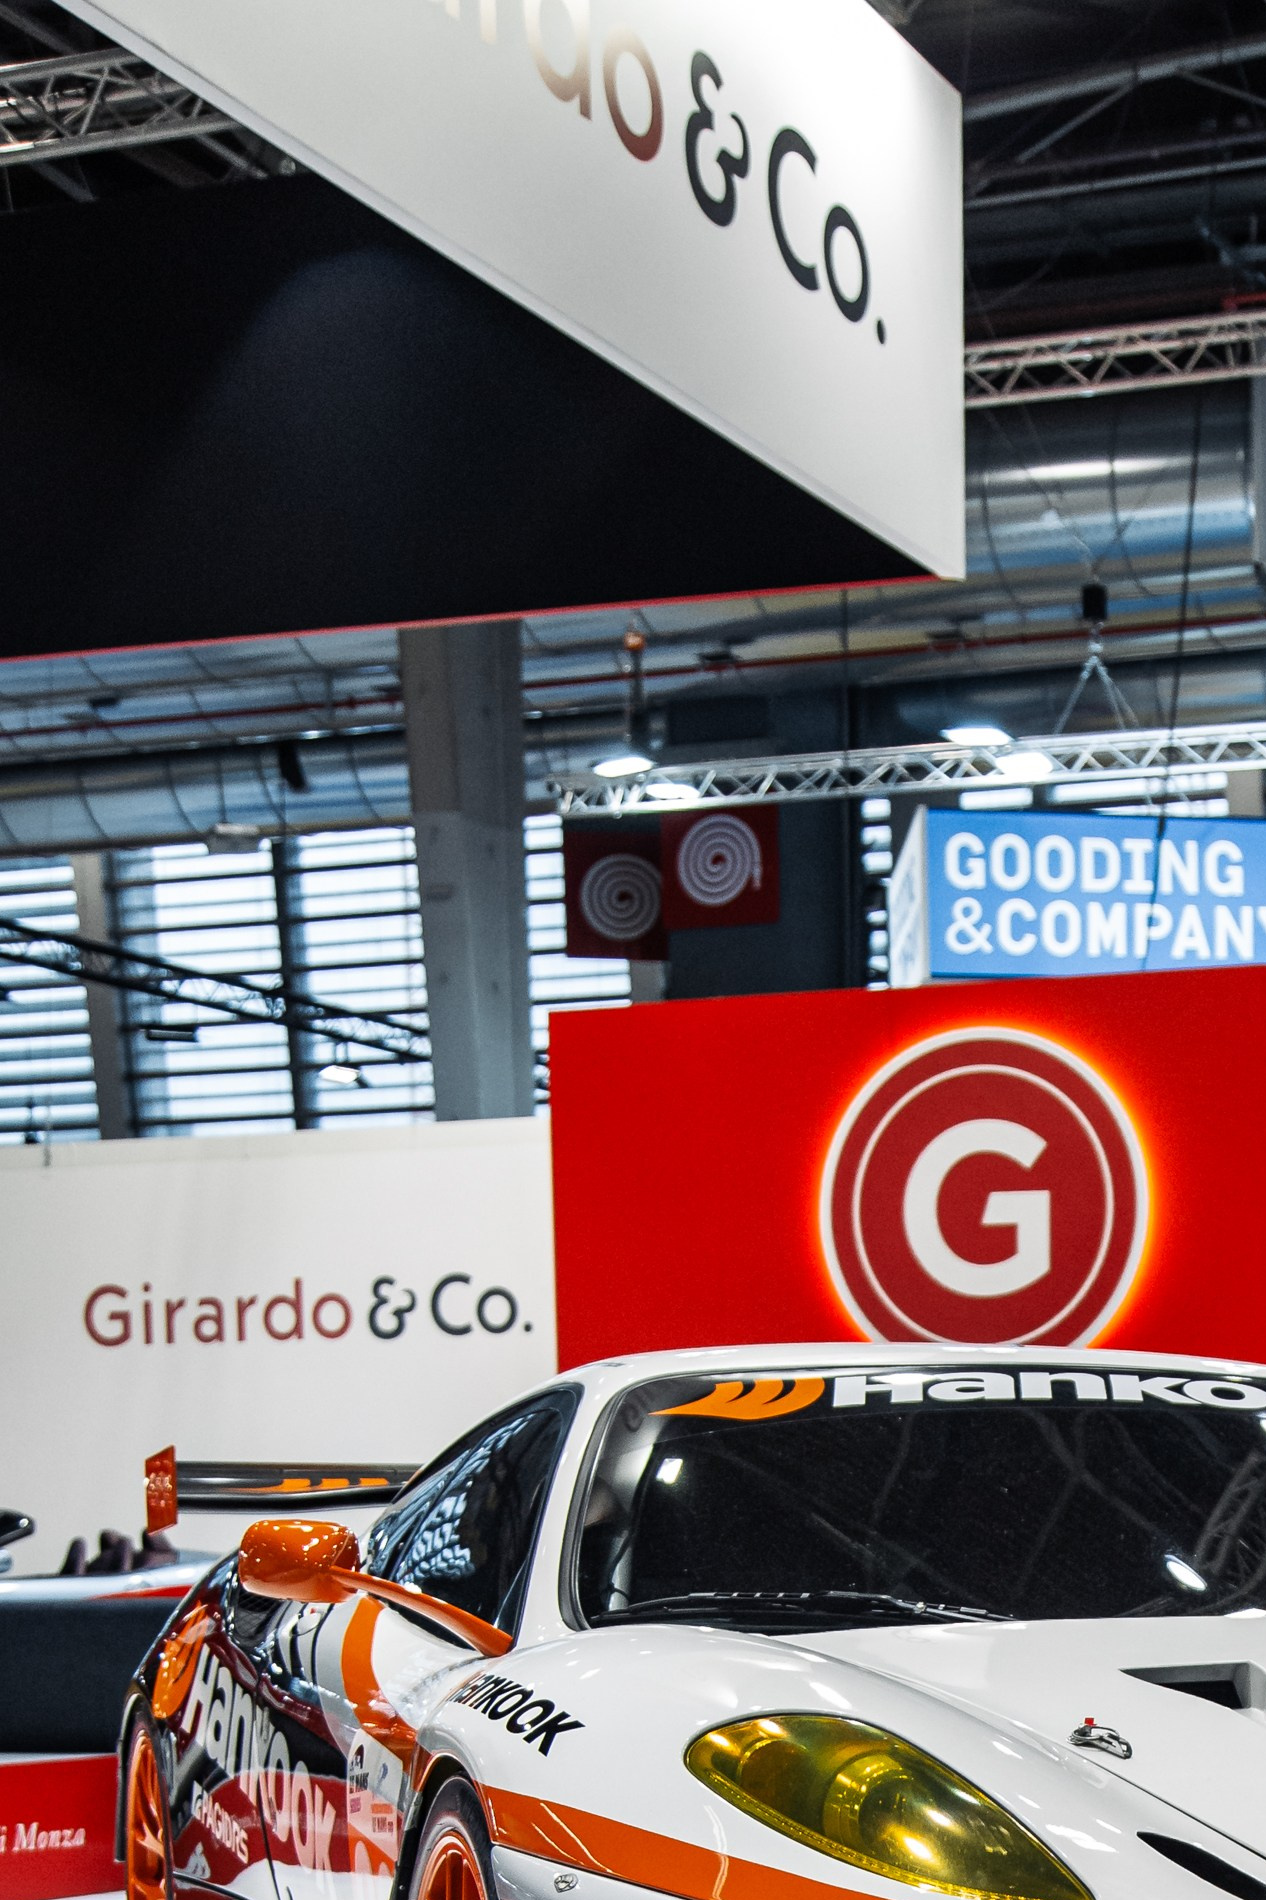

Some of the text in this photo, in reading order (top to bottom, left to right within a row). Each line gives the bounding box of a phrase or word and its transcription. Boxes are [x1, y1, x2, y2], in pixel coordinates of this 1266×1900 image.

[944, 832, 1245, 898] GOODING
[903, 1118, 1051, 1298] G
[83, 1276, 353, 1347] Girardo
[12, 1822, 86, 1853] Monza
